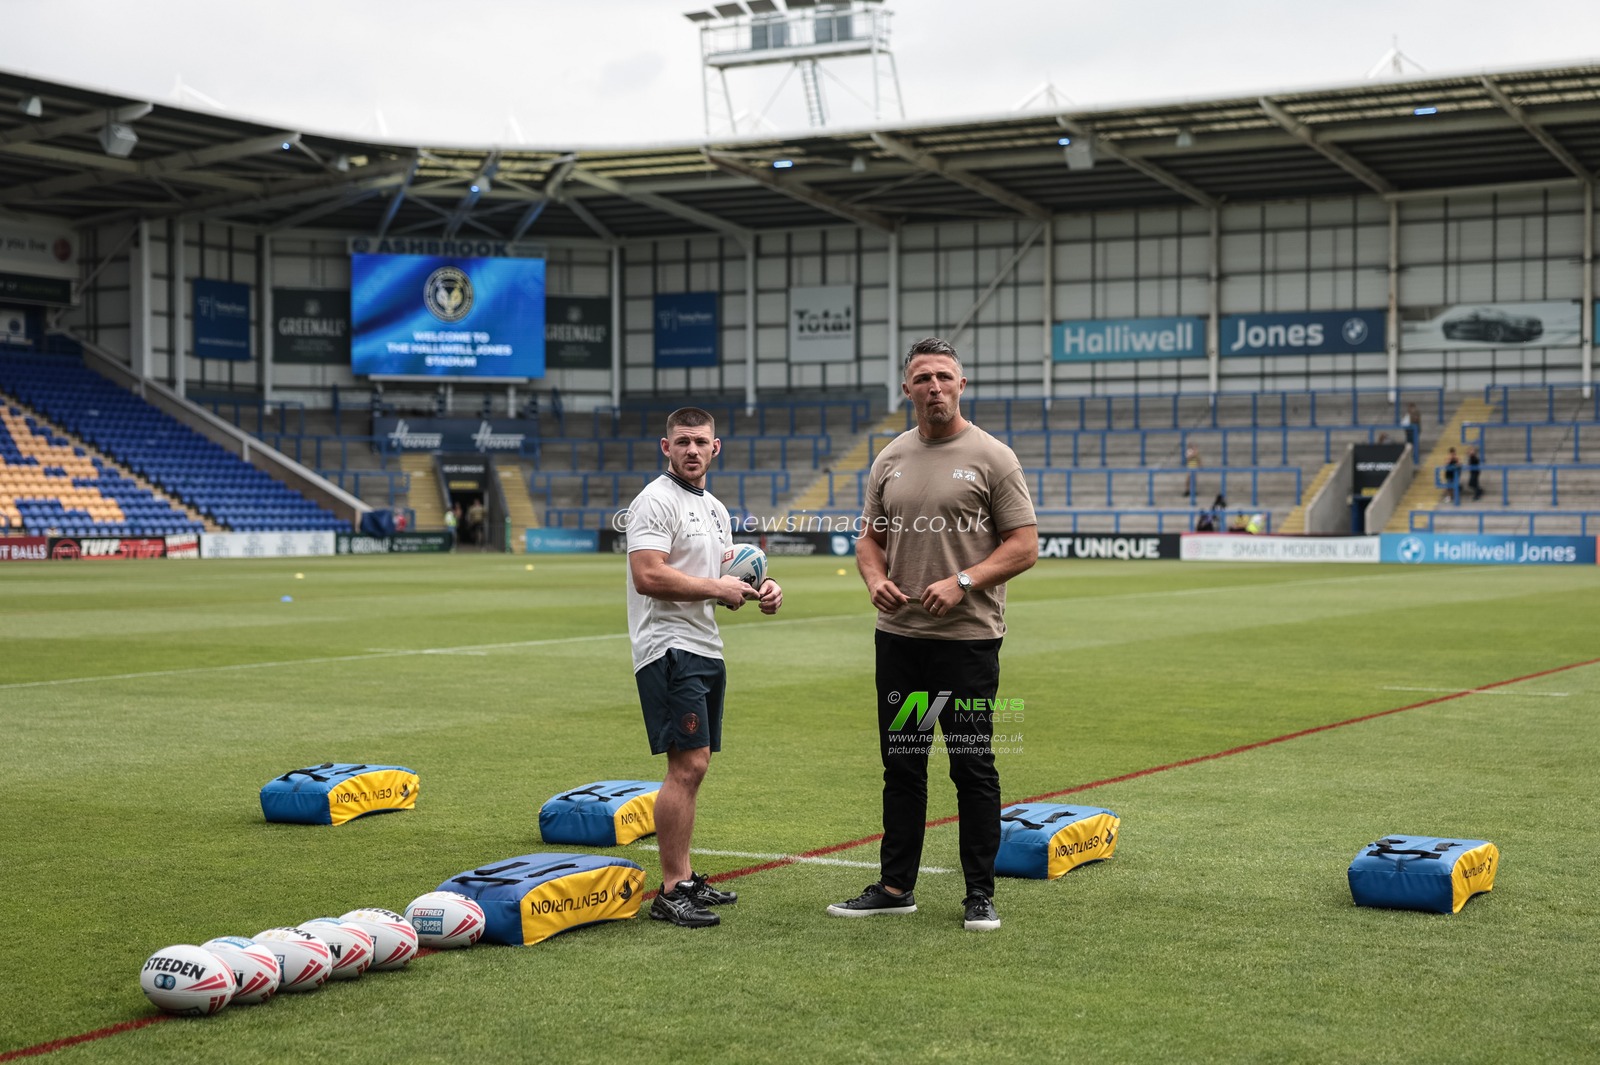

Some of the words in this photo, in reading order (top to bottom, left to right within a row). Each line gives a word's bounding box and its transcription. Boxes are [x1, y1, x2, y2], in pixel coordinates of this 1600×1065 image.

[377, 239, 509, 257] ASHBROOK
[793, 305, 851, 333] Total
[412, 329, 472, 343] WELCOME
[473, 331, 490, 344] TO
[1064, 322, 1194, 354] Halliwell
[1231, 319, 1325, 351] Jones
[387, 341, 410, 354] THE
[411, 343, 474, 356] HALLIWELL
[475, 344, 513, 356] JONES
[425, 355, 477, 368] STADIUM
[11, 544, 48, 560] BALLS
[80, 538, 121, 556] TUFF
[1038, 537, 1073, 558] EAT
[1074, 537, 1160, 560] UNIQUE
[1281, 542, 1334, 559] MODERN
[1344, 542, 1376, 558] LAW
[1433, 541, 1516, 561] Halliwell
[1519, 542, 1577, 563] Jones
[336, 787, 392, 804] CENTURION
[1055, 835, 1100, 858] CENTURION
[531, 889, 608, 916] CENTURION
[413, 908, 444, 917] BETFRED
[422, 920, 442, 928] SUPER
[144, 957, 206, 980] STEEDEN
